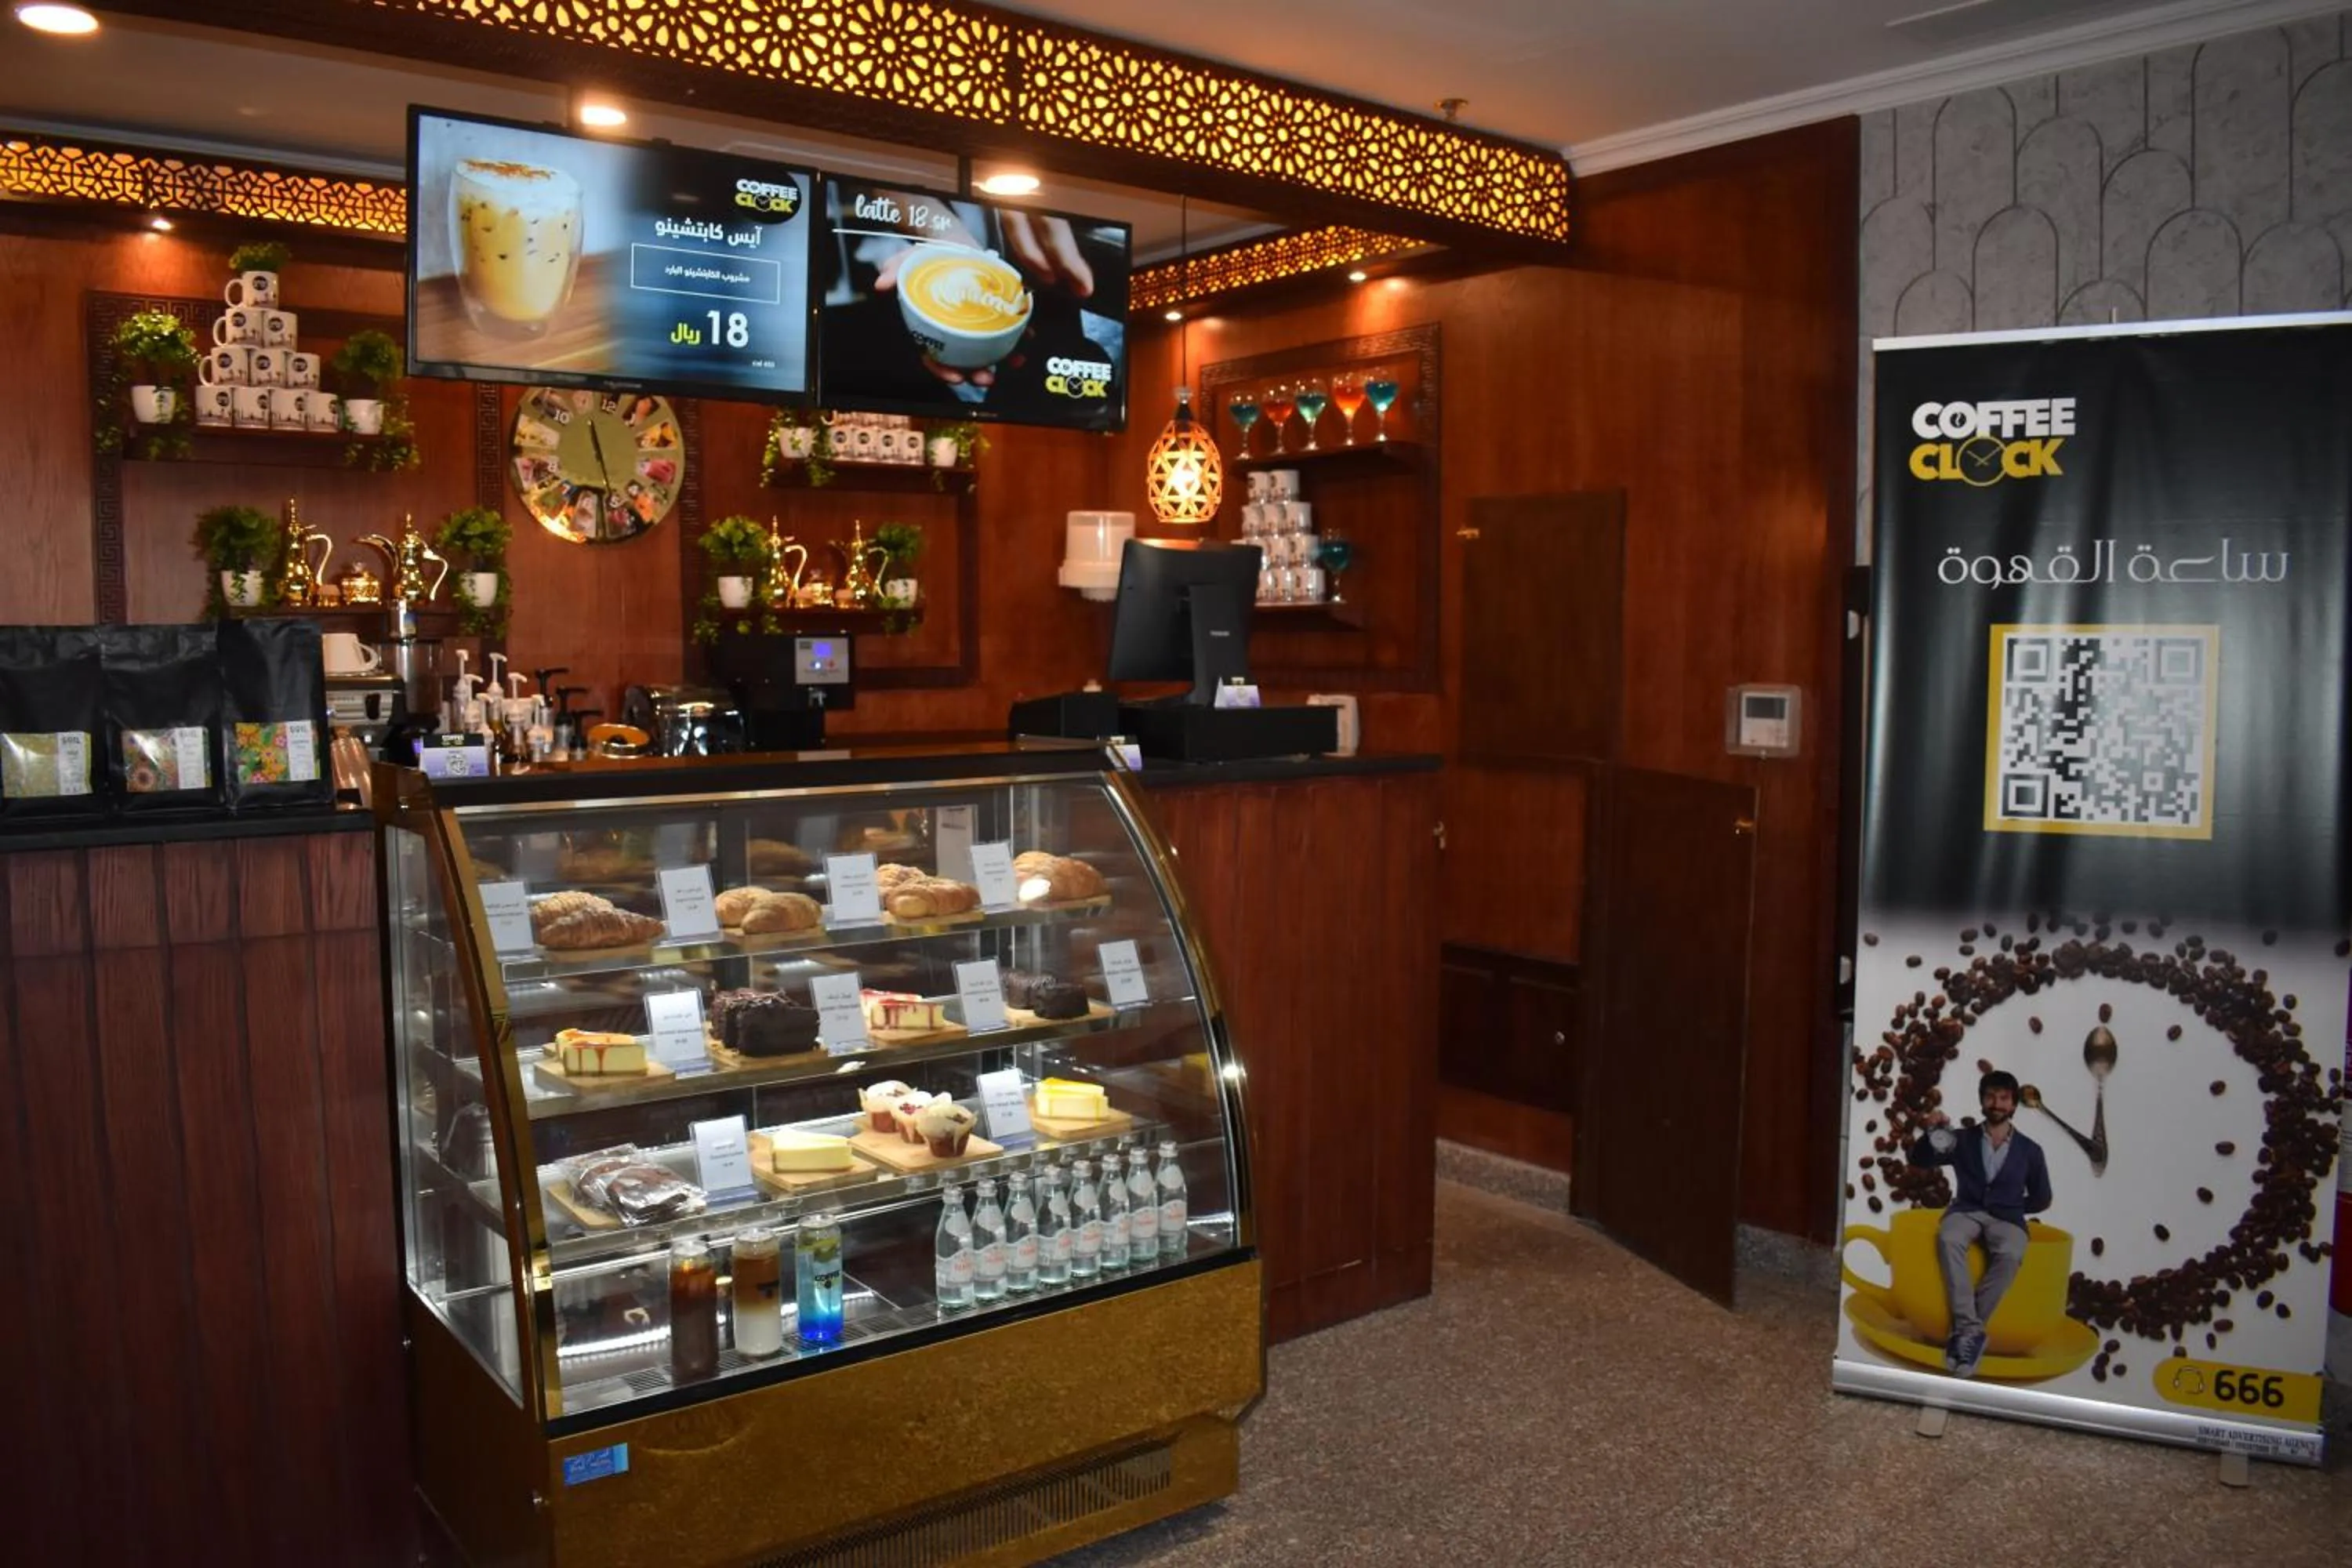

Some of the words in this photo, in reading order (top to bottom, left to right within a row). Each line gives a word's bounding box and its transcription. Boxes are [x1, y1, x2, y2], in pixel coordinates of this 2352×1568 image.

[735, 192, 793, 212] CLOCK
[736, 178, 797, 201] COFFEE
[855, 194, 902, 223] latte
[908, 205, 929, 228] 18
[655, 216, 724, 241] كابتشينو
[670, 322, 701, 345] ريال
[706, 309, 750, 348] 18
[1047, 357, 1112, 382] COFFEE
[1045, 375, 1107, 399] CLOCK
[554, 409, 570, 425] 10
[1911, 398, 2076, 439] COFFEE
[1909, 436, 2063, 487] CLOCK
[1937, 539, 2116, 590] القهوة
[2128, 539, 2289, 583] ساعة
[2214, 1369, 2285, 1408] 666
